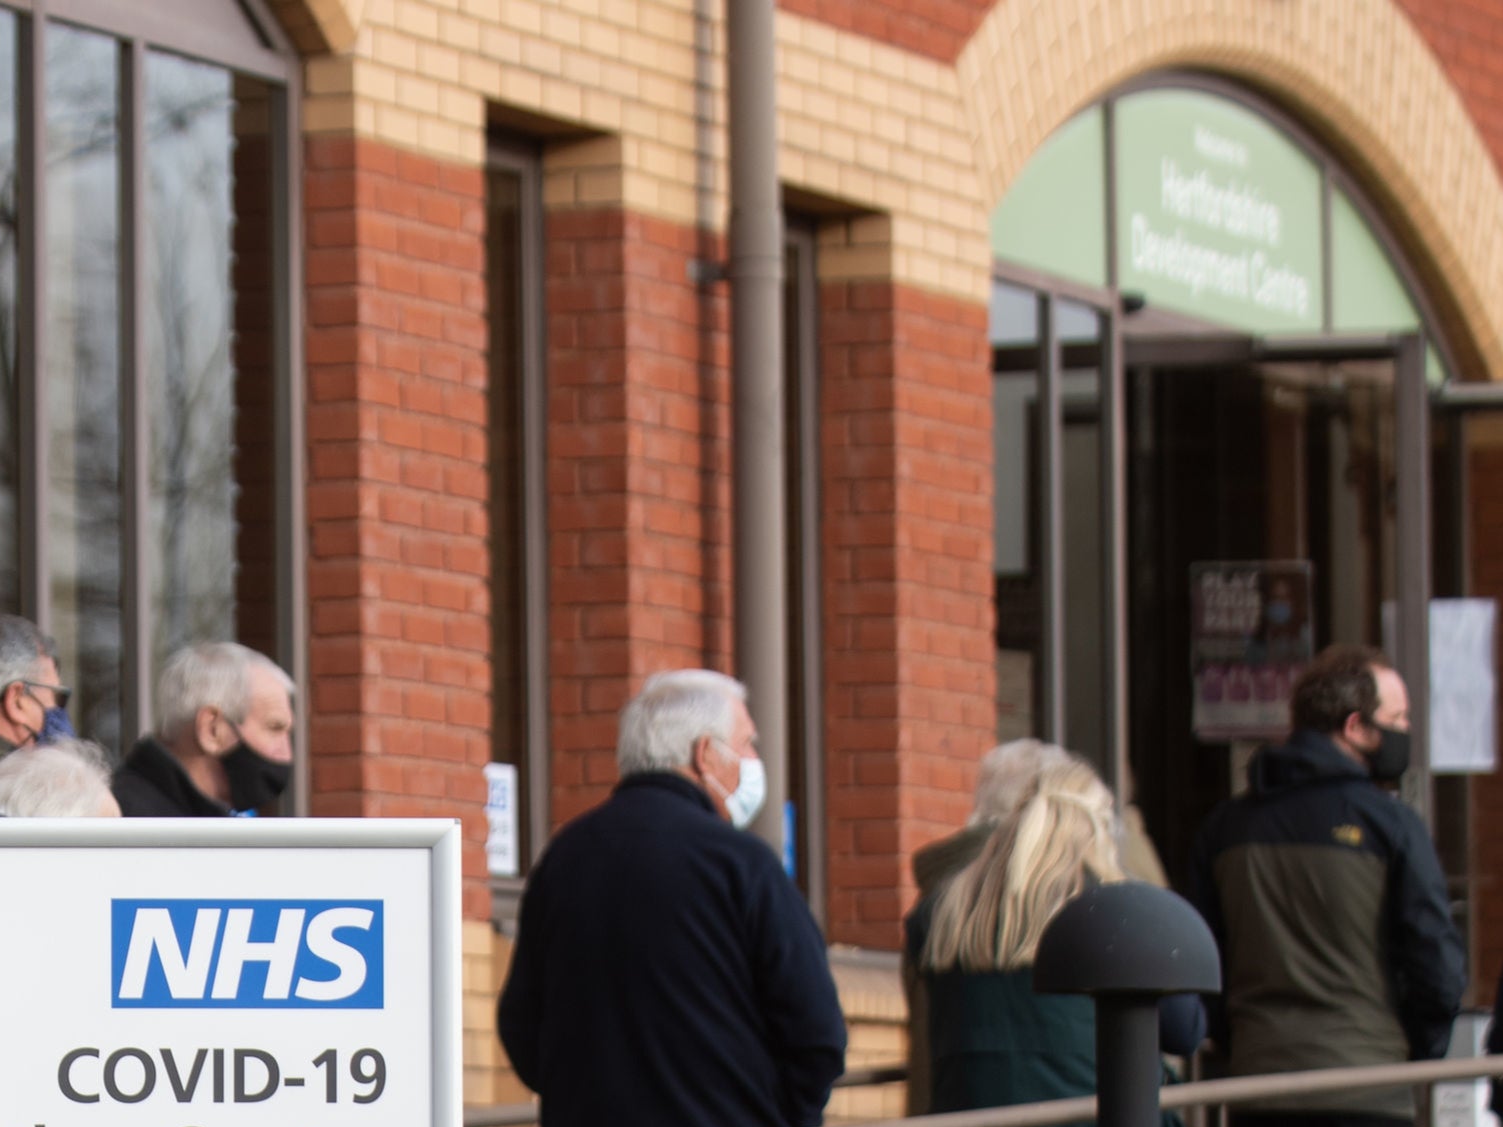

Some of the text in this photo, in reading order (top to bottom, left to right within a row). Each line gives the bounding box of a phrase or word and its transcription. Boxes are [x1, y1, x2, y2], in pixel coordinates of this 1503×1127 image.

[1131, 211, 1309, 319] Development Centre
[117, 907, 375, 1002] NHS
[57, 1046, 388, 1105] COVID-19
